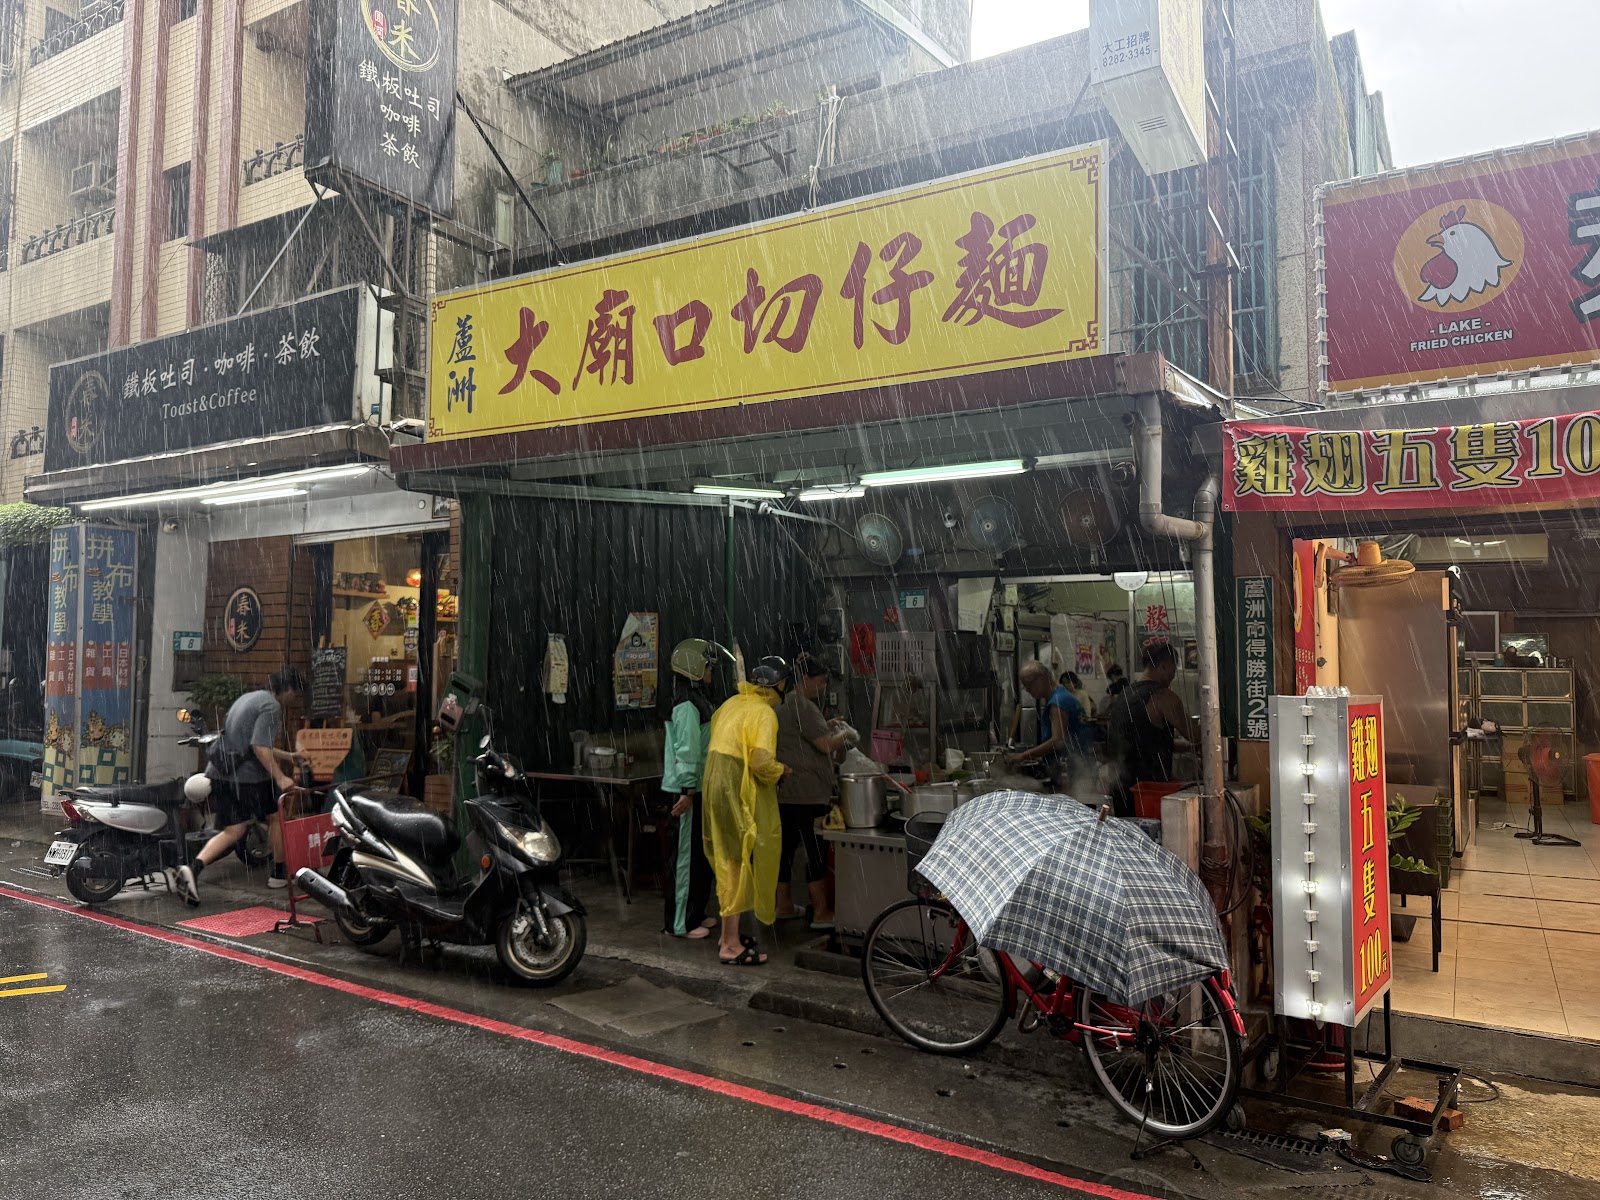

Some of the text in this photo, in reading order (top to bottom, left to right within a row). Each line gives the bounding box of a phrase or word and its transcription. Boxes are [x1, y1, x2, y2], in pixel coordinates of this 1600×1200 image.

[1102, 31, 1150, 55] 大工招牌
[358, 59, 440, 122] 鐵板吐司
[380, 103, 421, 138] 咖啡
[380, 132, 421, 170] 茶飲
[497, 211, 1065, 396] 大廟口切仔麵
[1410, 329, 1513, 352] FRIED CHICKEN
[1438, 318, 1482, 334] LAKE
[447, 314, 478, 414] 蘆洲
[162, 387, 257, 420] Toast&Coffee
[912, 596, 918, 607] 6
[188, 638, 194, 649] 8
[1244, 579, 1268, 738] 蘆洲市得勝街2號
